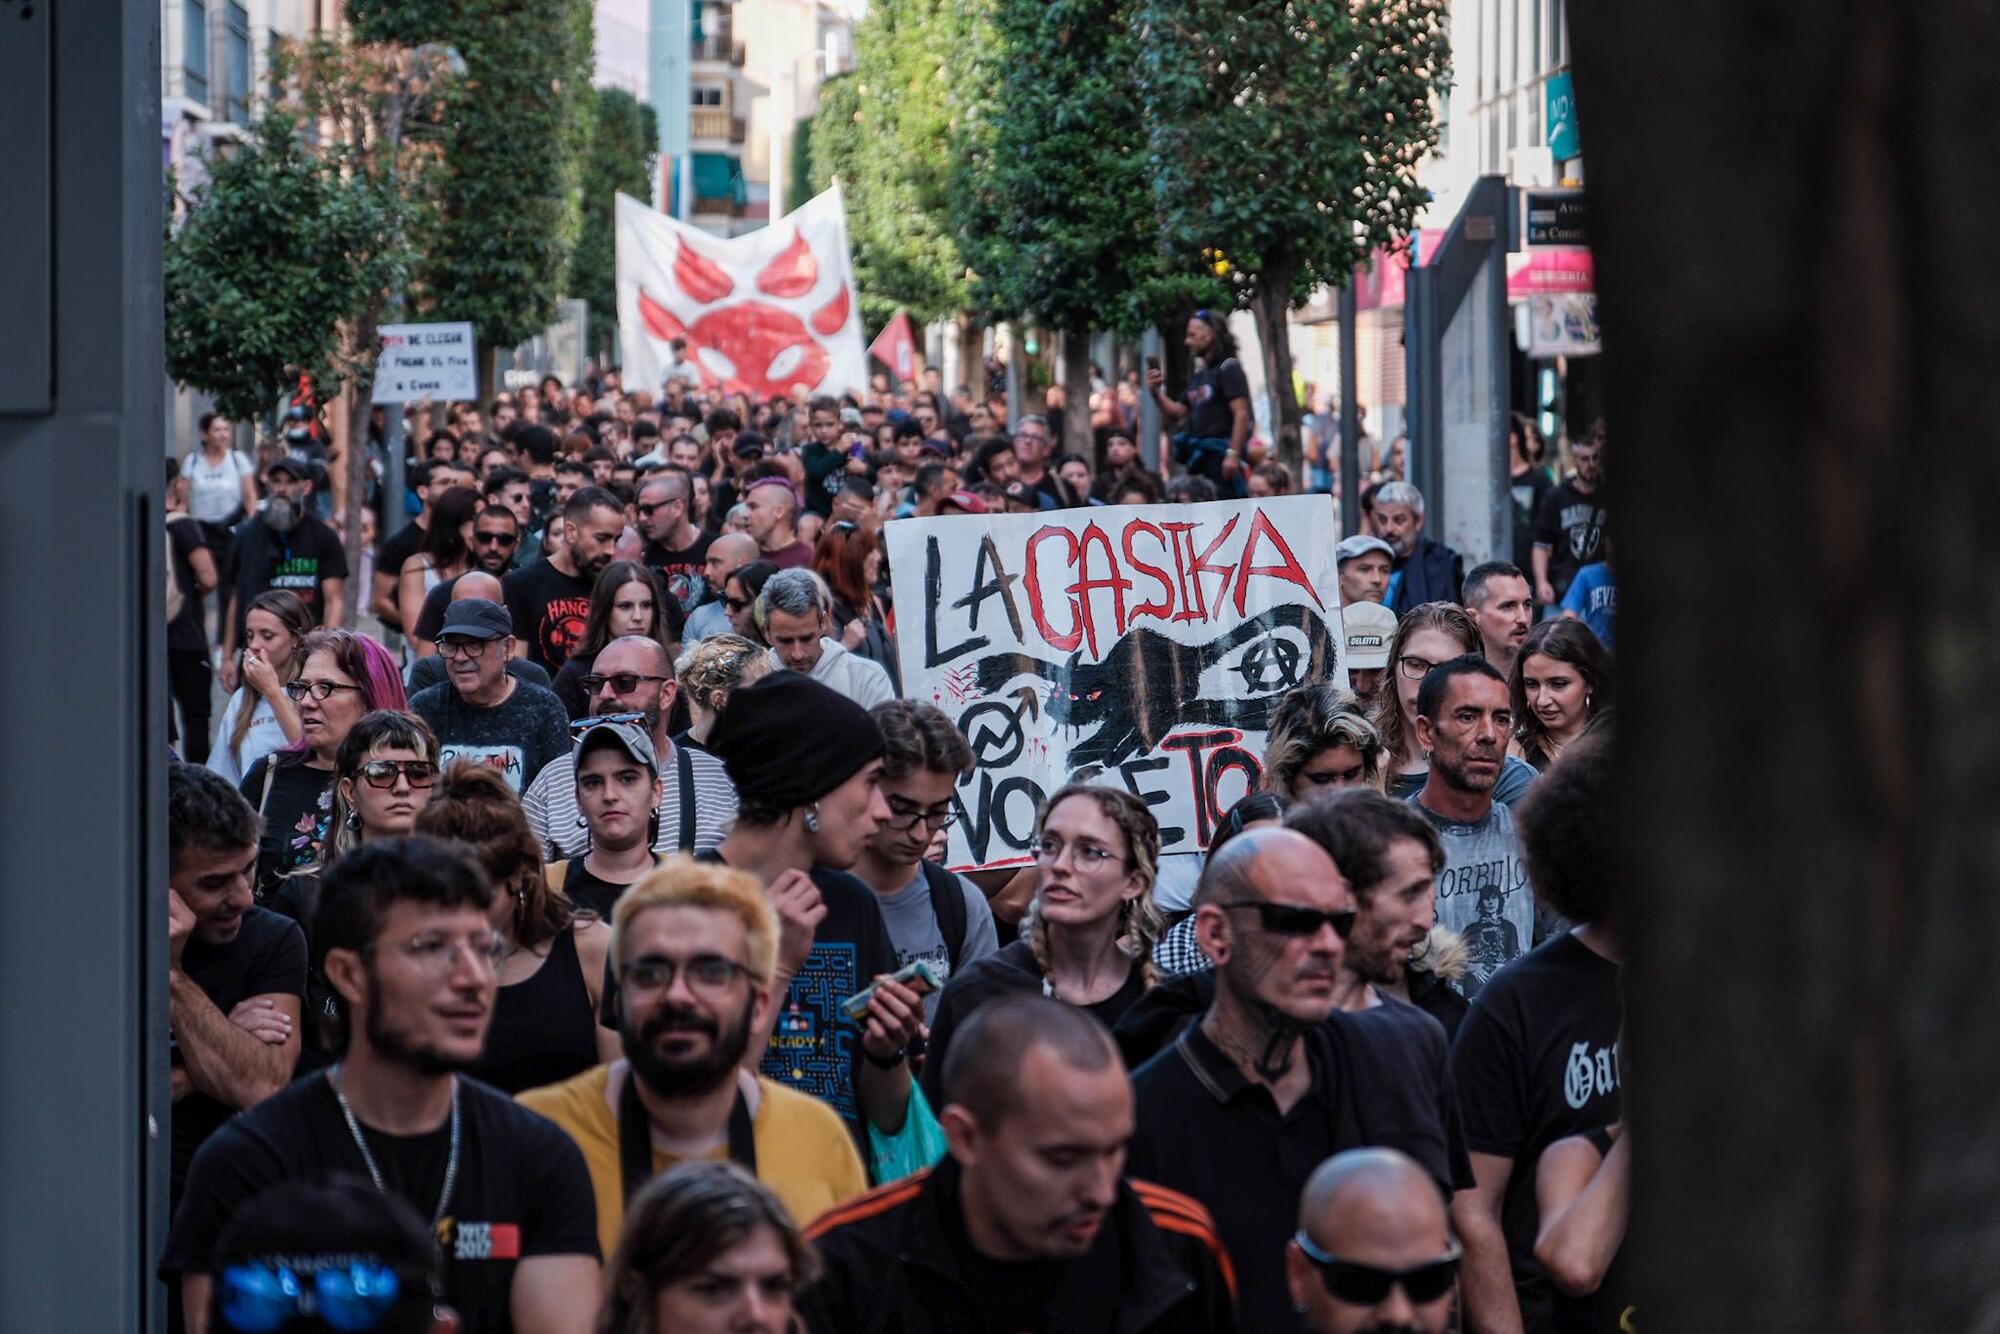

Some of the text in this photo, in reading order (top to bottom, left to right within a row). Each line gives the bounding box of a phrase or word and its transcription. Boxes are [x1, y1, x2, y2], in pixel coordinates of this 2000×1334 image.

[925, 507, 1326, 669] LA CASIKA
[1161, 728, 1265, 849] TO
